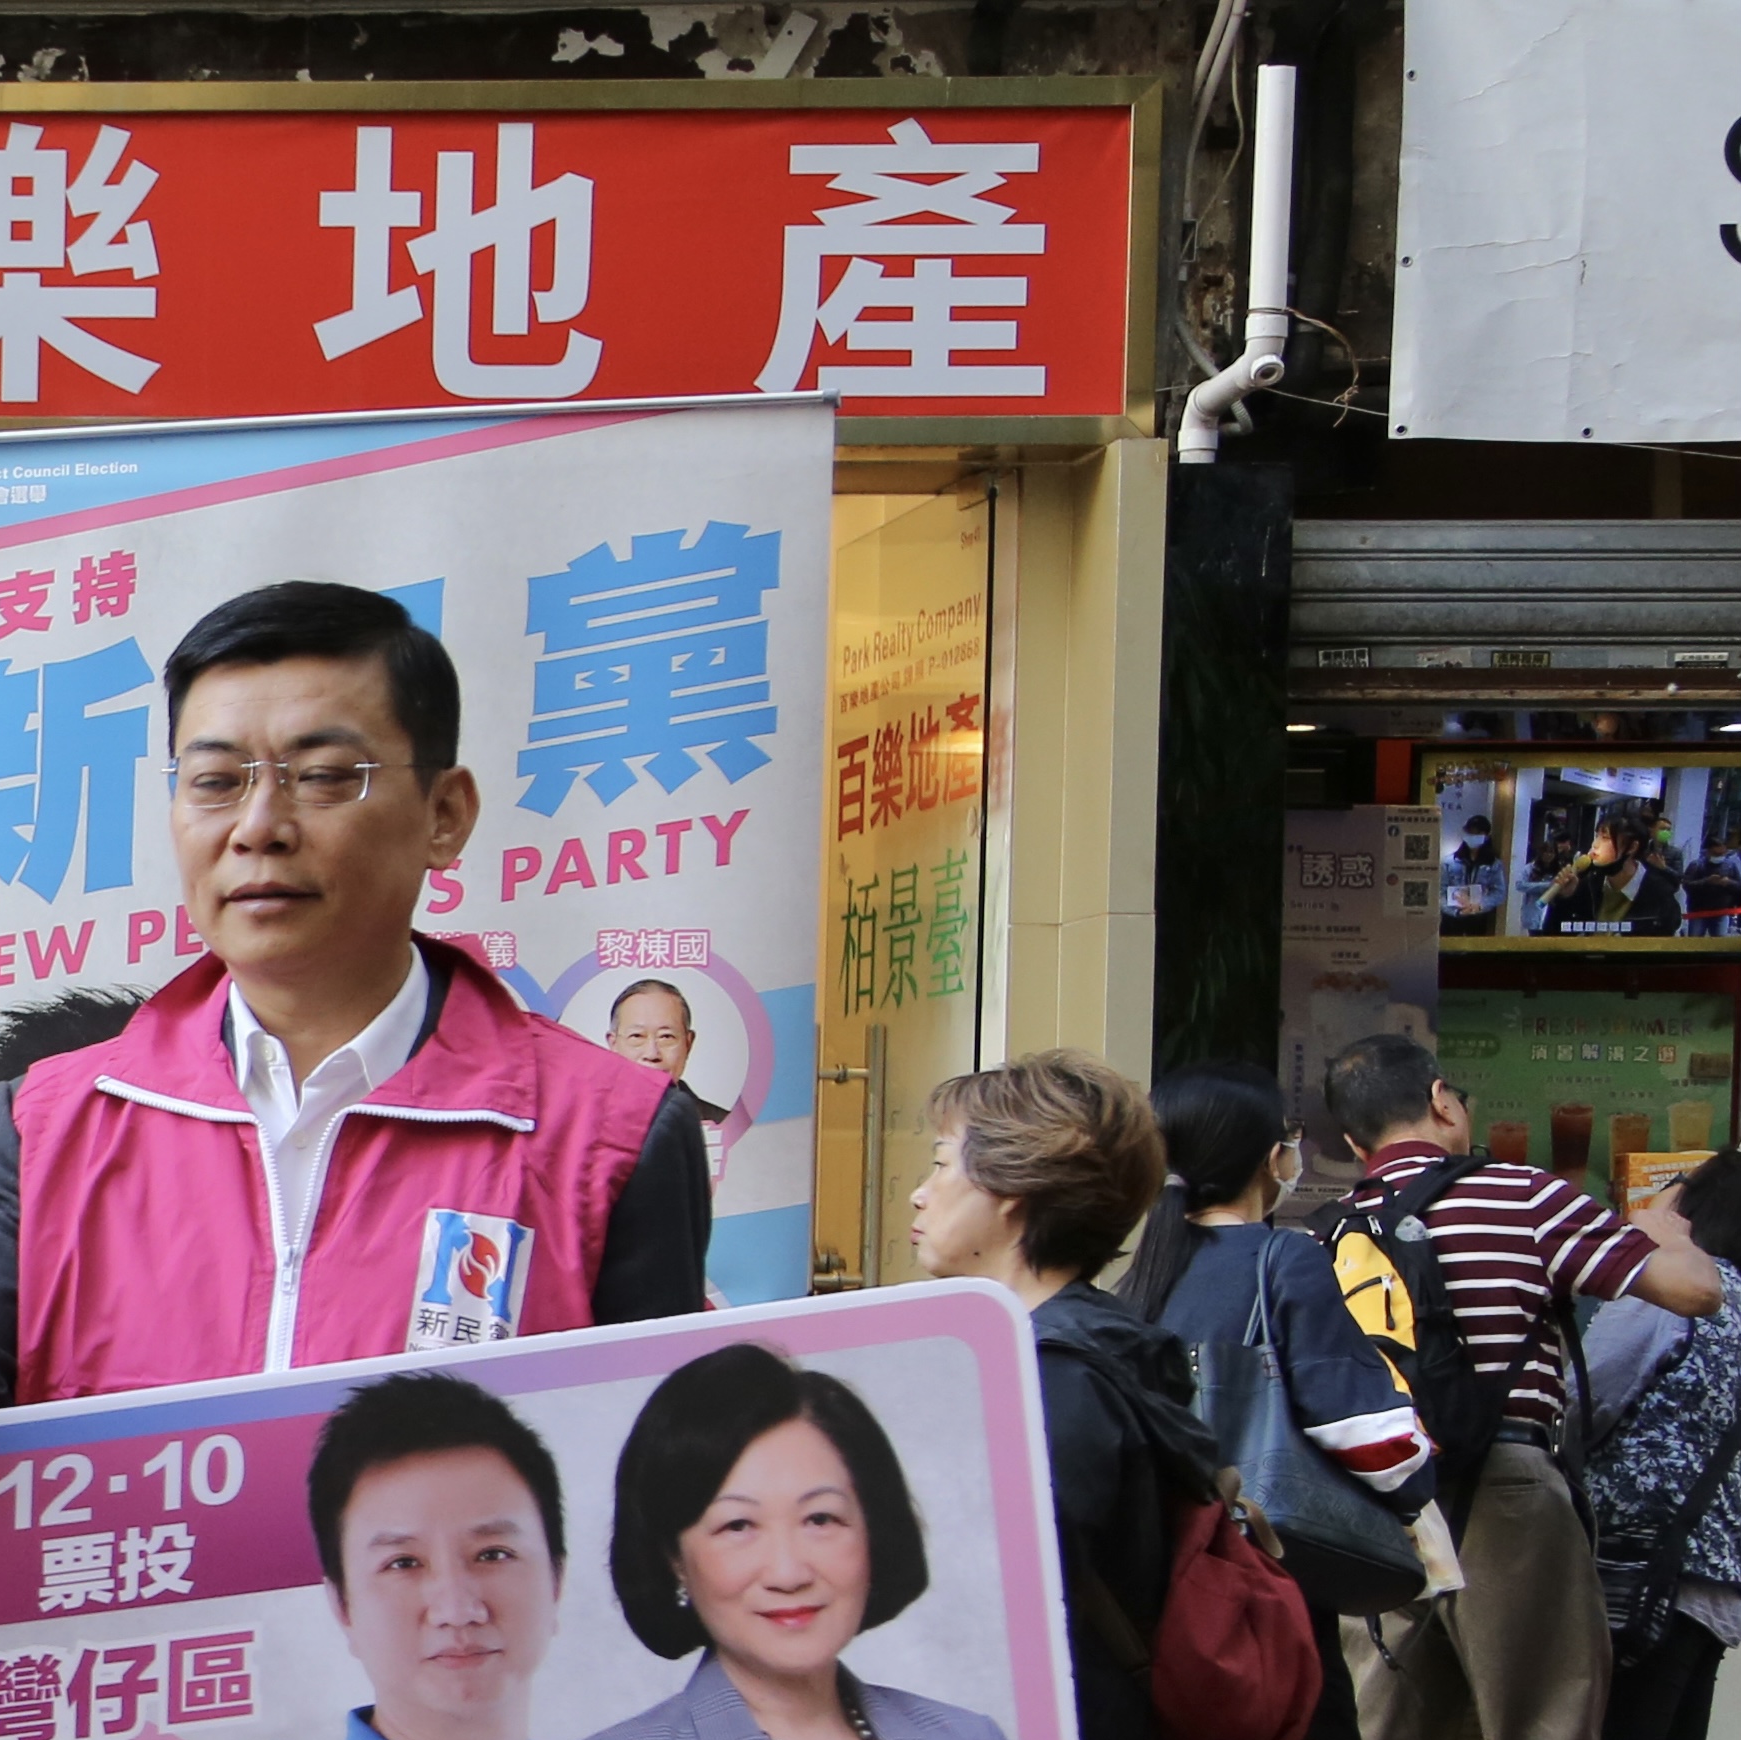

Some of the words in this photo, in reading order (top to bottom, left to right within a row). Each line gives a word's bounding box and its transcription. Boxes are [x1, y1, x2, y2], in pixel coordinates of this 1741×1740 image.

[14, 464, 70, 481] Council
[75, 460, 139, 477] Election
[843, 637, 870, 679] Park
[873, 620, 914, 665] Realty
[918, 592, 982, 644] Company
[837, 692, 981, 842] 百樂地產
[499, 806, 751, 904] PARTY
[598, 929, 710, 968] 黎棟國
[38, 1523, 198, 1615] 票投
